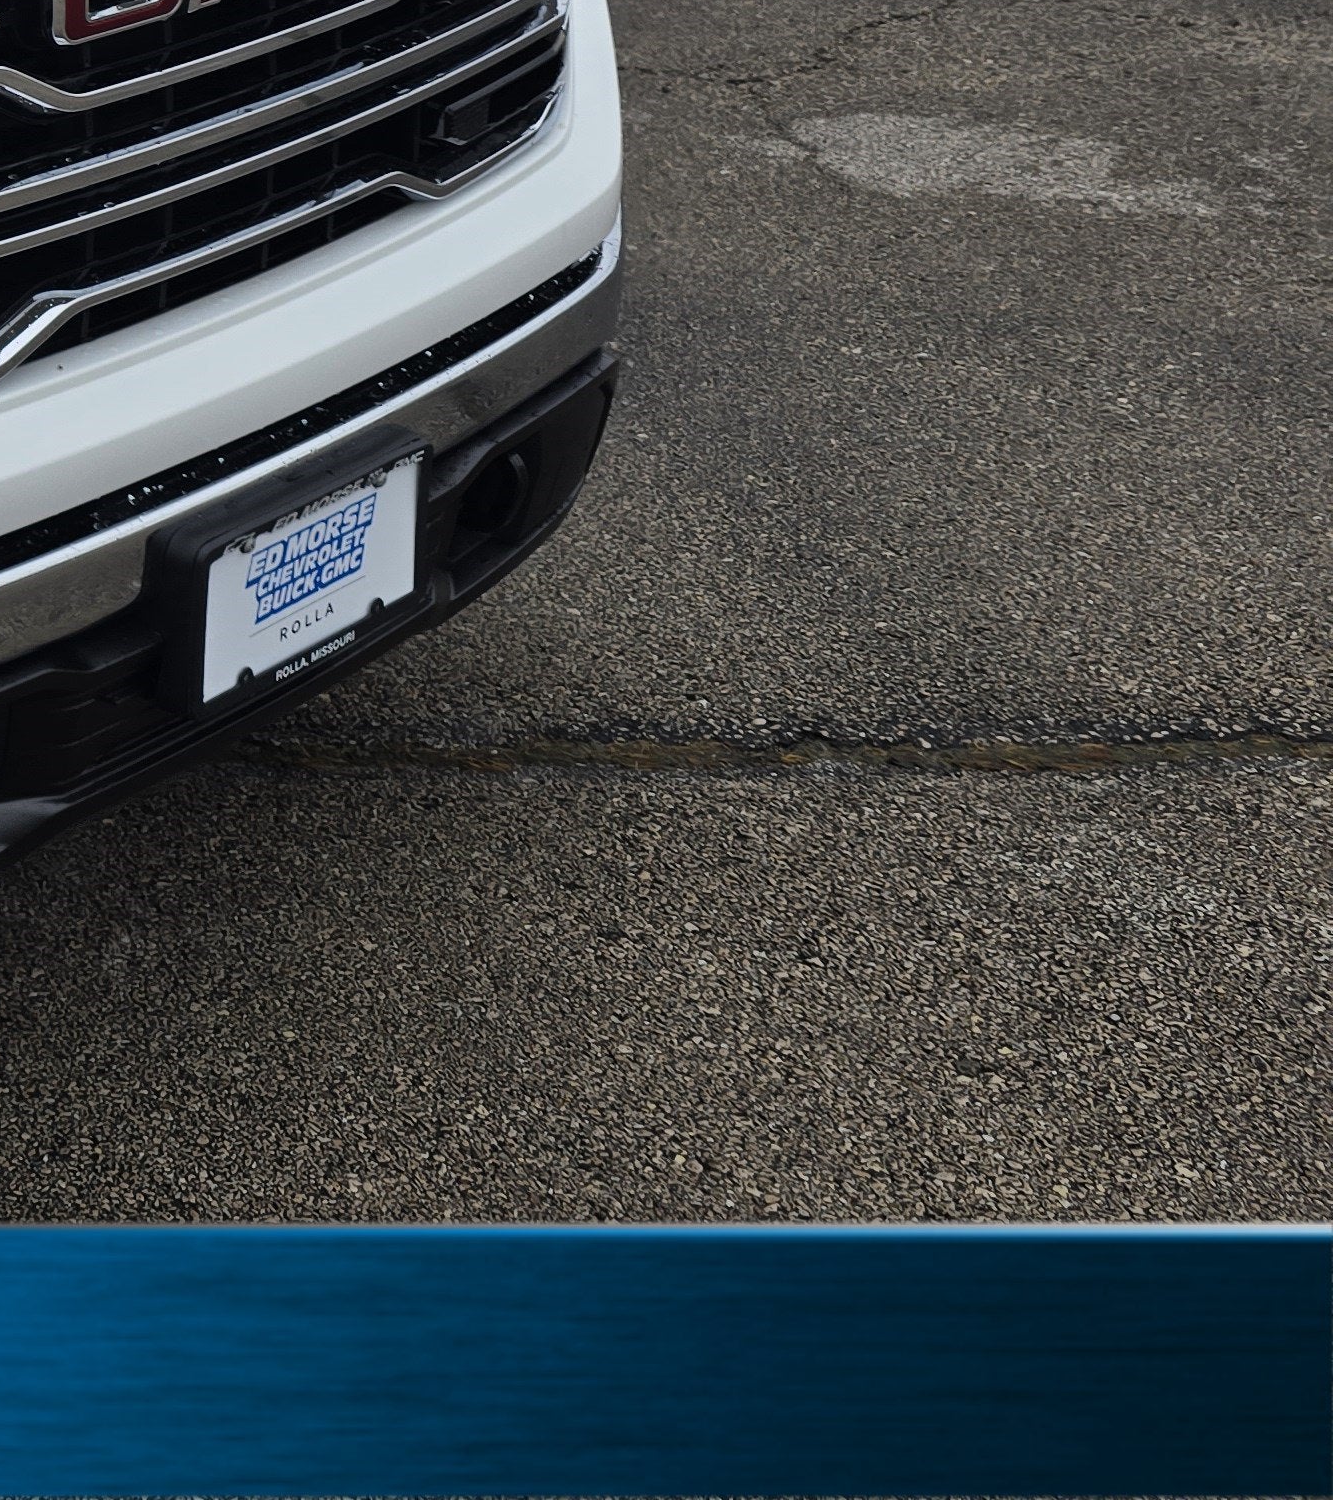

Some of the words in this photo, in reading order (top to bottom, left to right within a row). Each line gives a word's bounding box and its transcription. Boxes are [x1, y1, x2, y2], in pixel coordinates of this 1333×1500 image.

[247, 542, 285, 584] ED
[284, 496, 375, 564] MORSE
[279, 601, 335, 643] ROLLA
[275, 656, 309, 682] ROLLA,
[310, 629, 356, 664] MISSOURI
